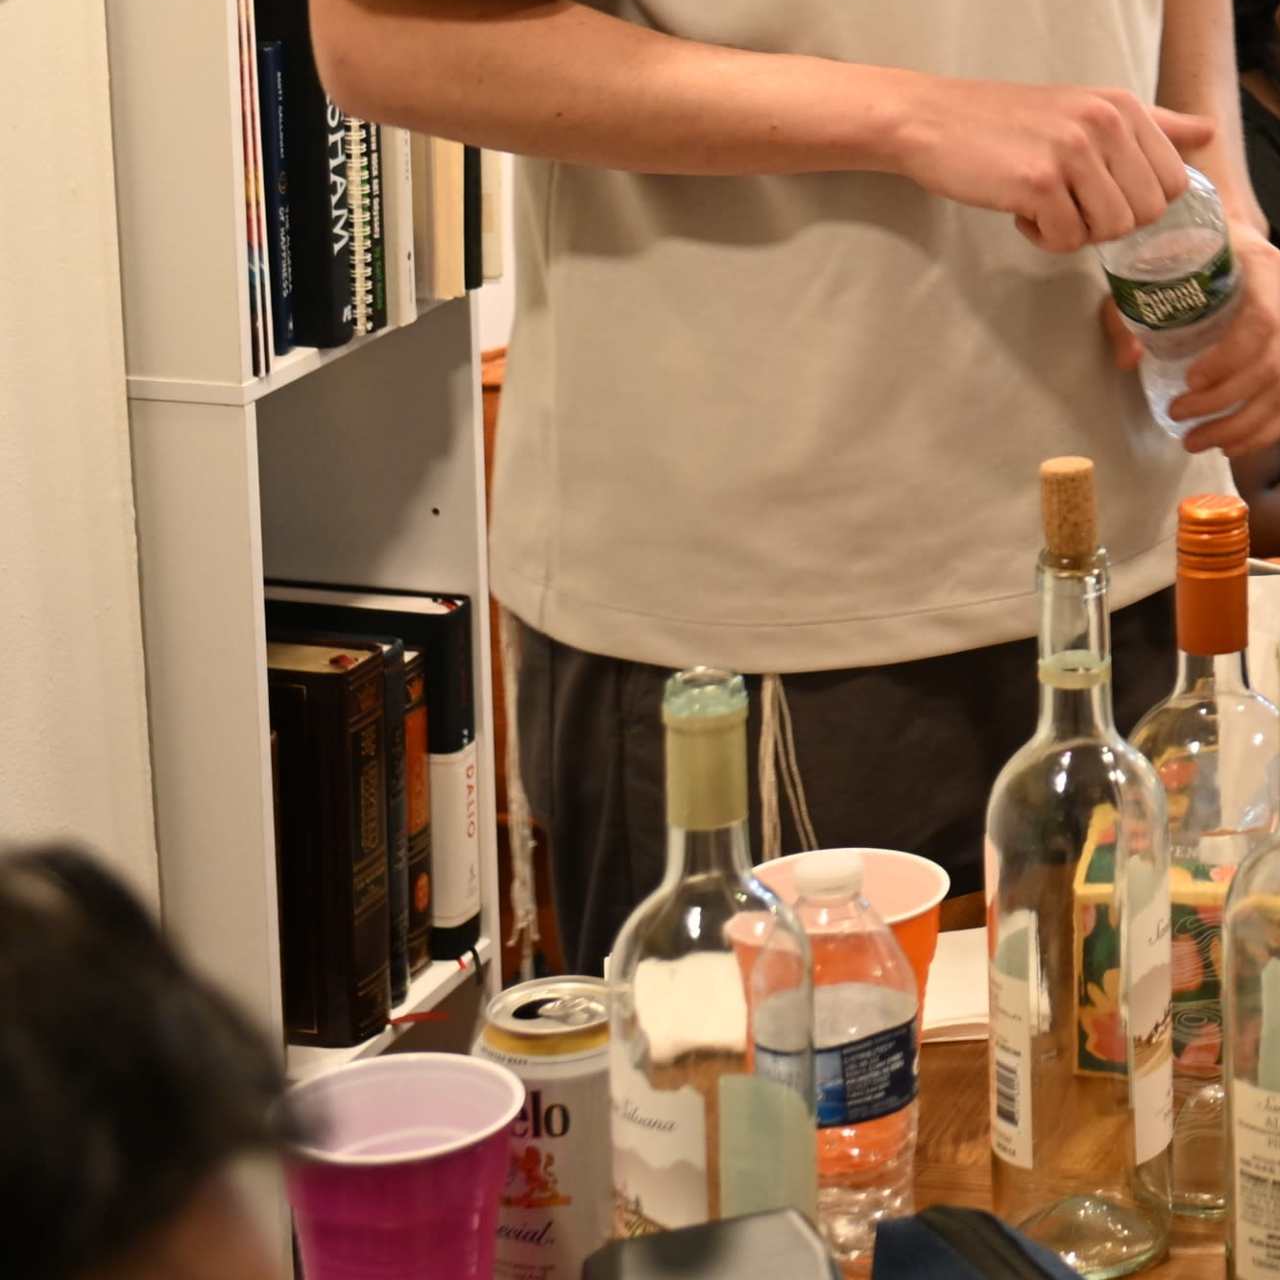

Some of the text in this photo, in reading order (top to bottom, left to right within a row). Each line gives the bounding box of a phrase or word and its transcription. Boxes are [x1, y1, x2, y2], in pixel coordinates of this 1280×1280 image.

[326, 96, 350, 257] SHAM
[465, 764, 477, 839] DALIO
[510, 1090, 570, 1139] elo
[496, 1220, 552, 1246] ecial
